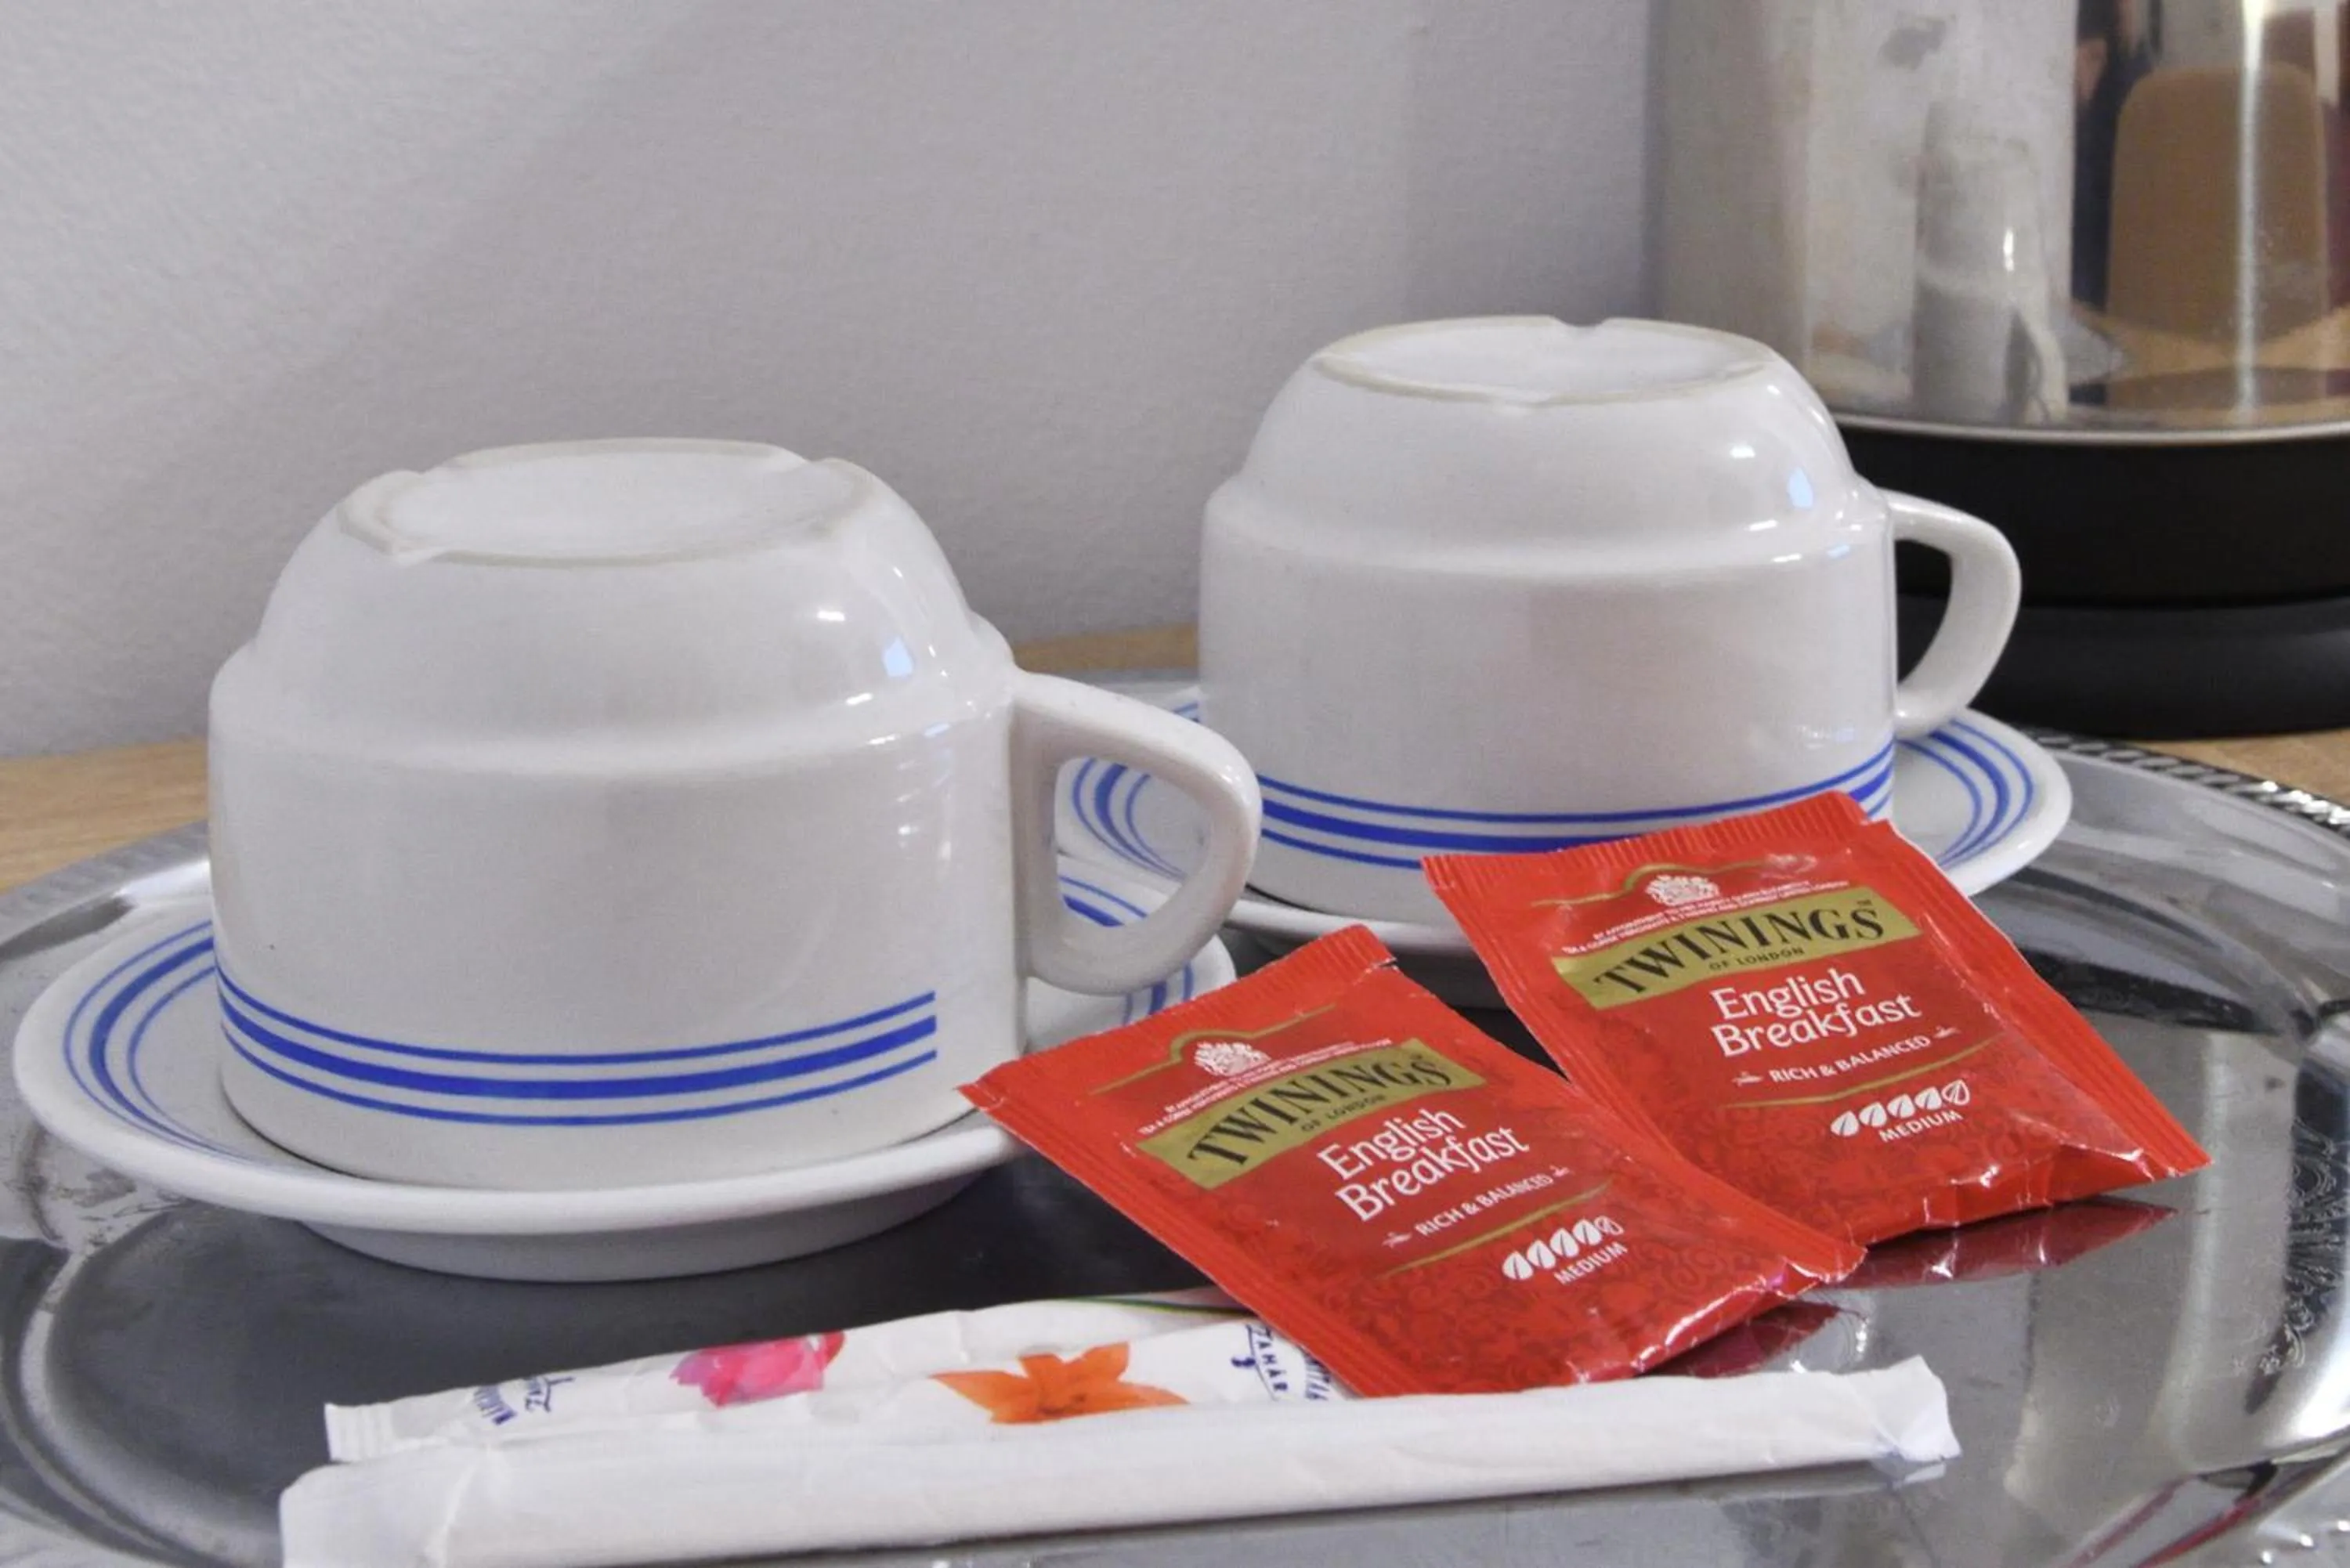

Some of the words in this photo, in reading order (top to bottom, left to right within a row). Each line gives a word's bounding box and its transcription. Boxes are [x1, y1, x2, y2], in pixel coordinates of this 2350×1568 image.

[1593, 905, 1884, 996] TWININGS
[1708, 959, 1729, 970] OF
[1736, 946, 1805, 965] LONDON
[1710, 968, 1866, 1019] English
[1711, 994, 1922, 1057] Breakfast
[1769, 1064, 1818, 1082] RICH
[1819, 1064, 1835, 1076] &
[1835, 1035, 1931, 1071] BALANCED
[1187, 1058, 1454, 1167] TWININGS
[1317, 1108, 1466, 1180] English
[1879, 1109, 1964, 1144] MEDIUM
[1335, 1127, 1530, 1222] Breakfast
[1415, 1207, 1464, 1237] RICH
[1462, 1202, 1480, 1216] &
[1476, 1173, 1554, 1209] BALANCED
[1553, 1243, 1628, 1285] MEDIUM
